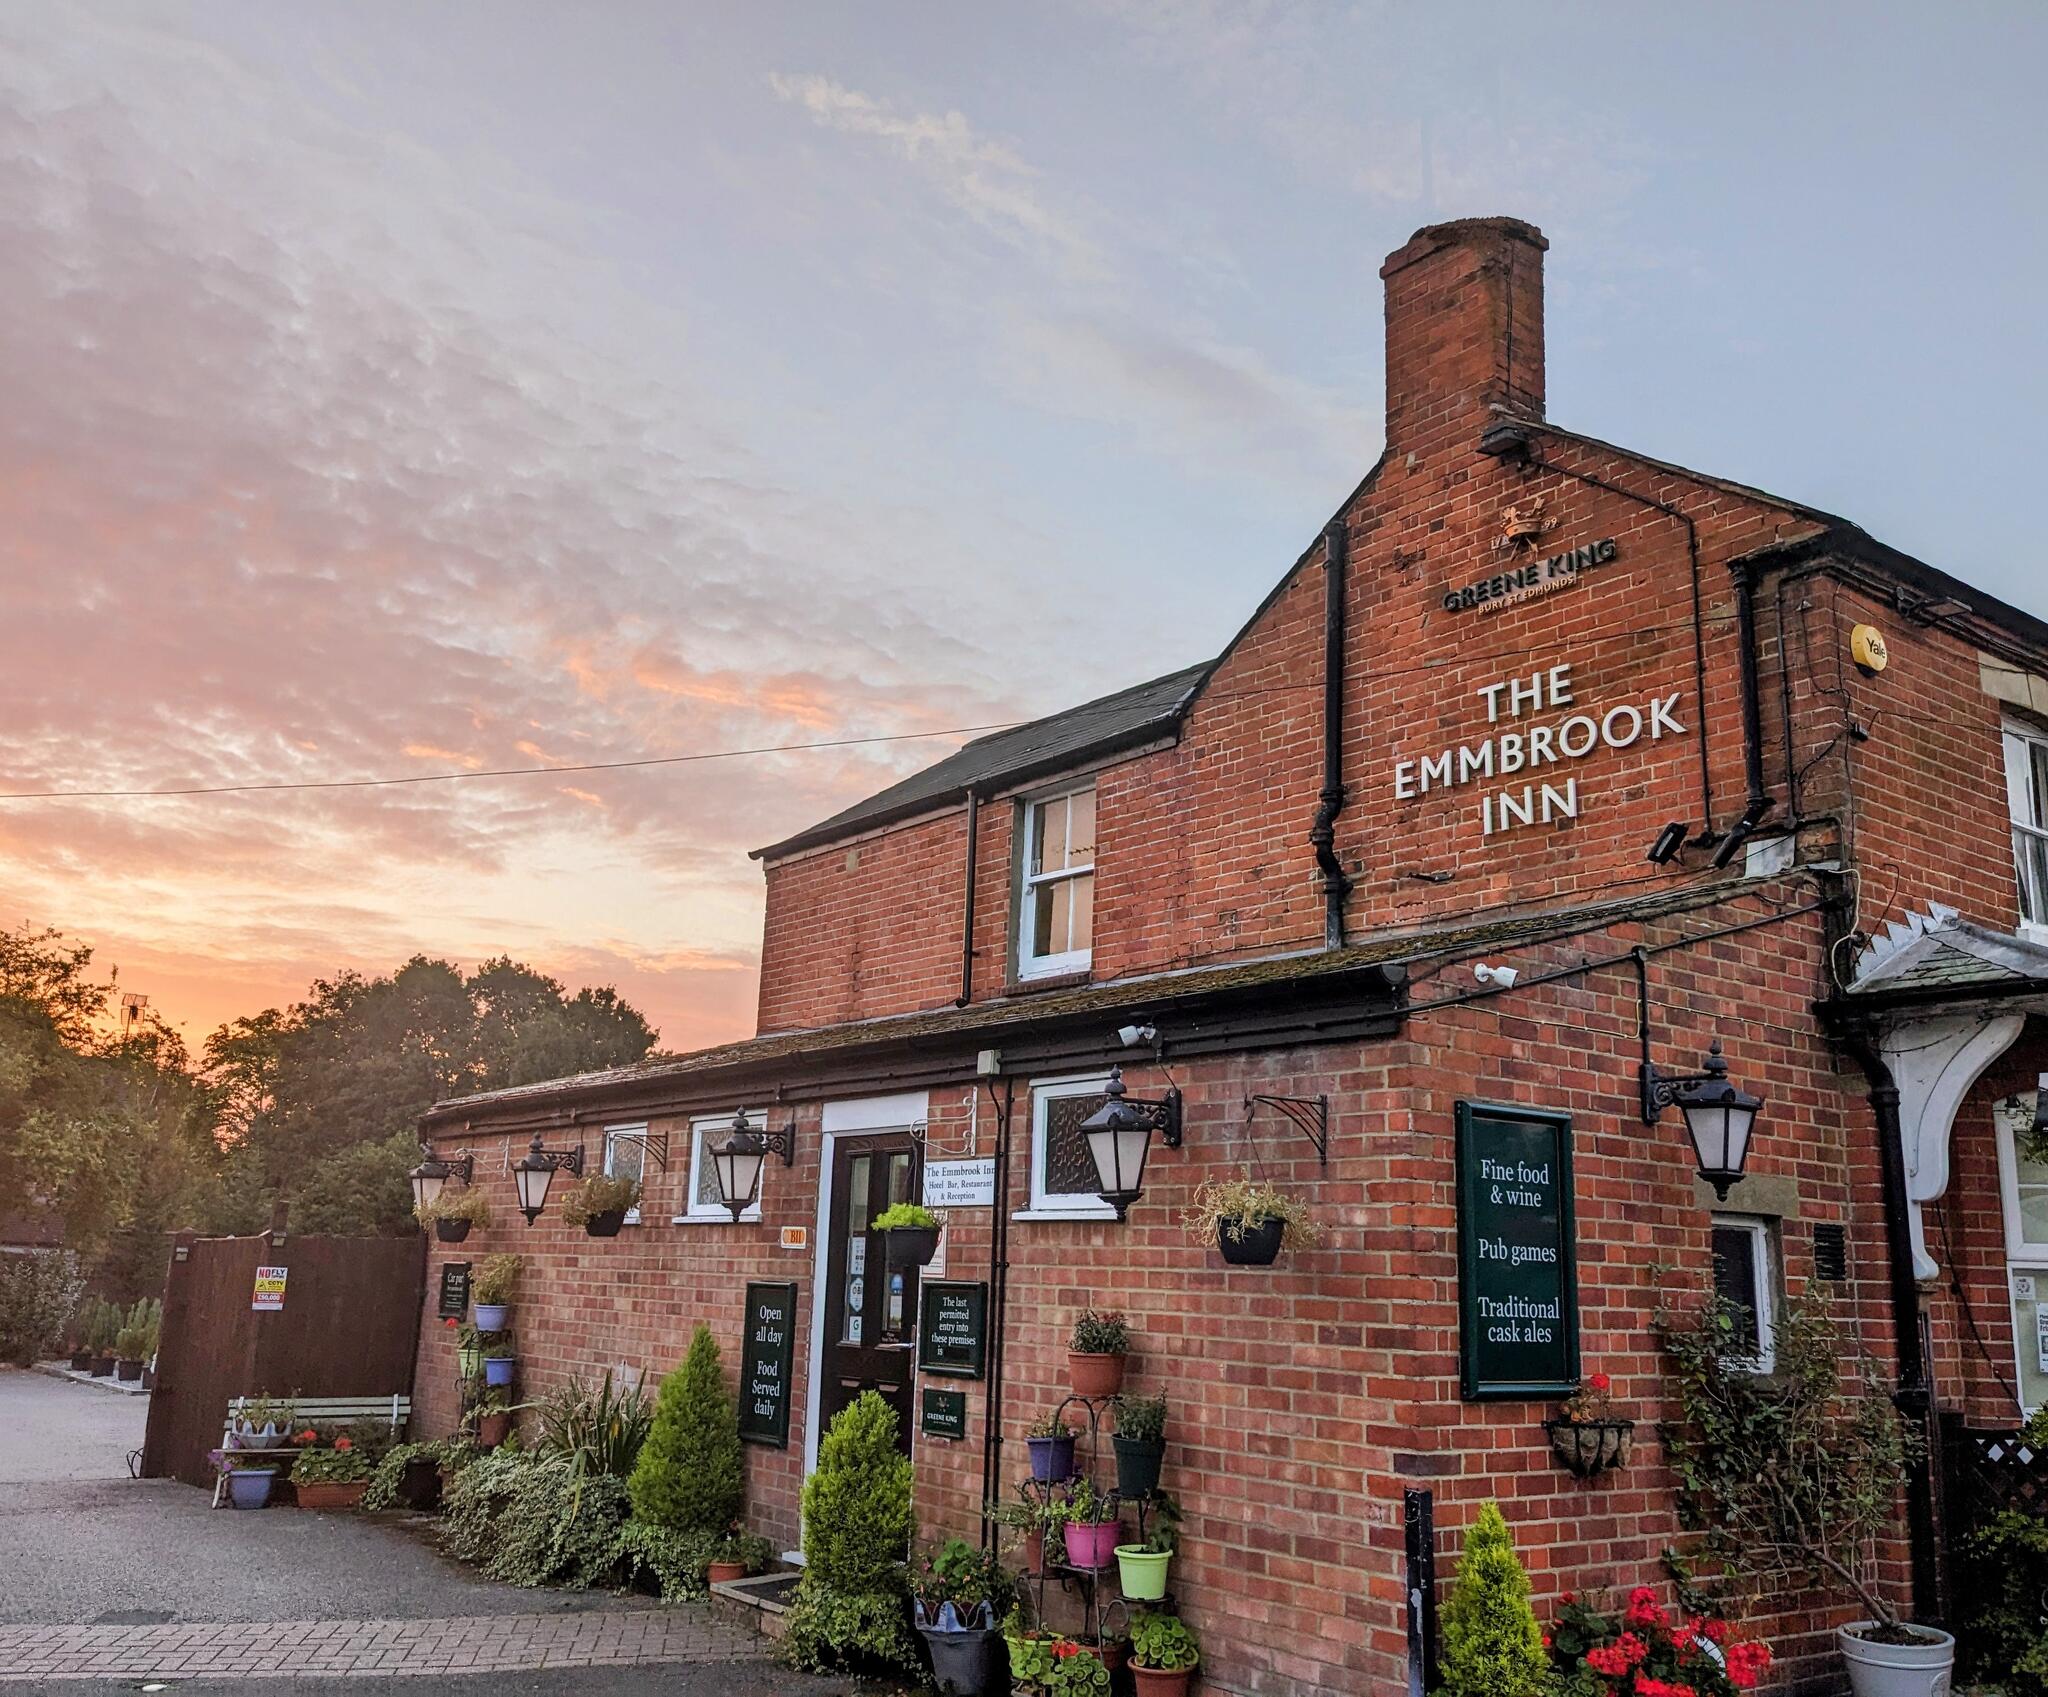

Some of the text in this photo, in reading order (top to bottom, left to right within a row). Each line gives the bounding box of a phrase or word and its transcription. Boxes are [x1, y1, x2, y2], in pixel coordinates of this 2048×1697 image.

[1443, 537, 1617, 611] GREENE KING
[1478, 576, 1574, 615] BURY ST EDMUNDS
[1866, 637, 1886, 659] Yale
[1477, 663, 1574, 723] THE
[1395, 692, 1688, 800] EMMBROOK
[1483, 778, 1578, 835] INN
[927, 1167, 940, 1178] The
[942, 1164, 981, 1177] Emmbrook
[1480, 1159, 1550, 1185] Fine food
[929, 1180, 992, 1190] Hotel Bar, Restaurant
[947, 1191, 976, 1202] Reception
[1490, 1184, 1542, 1207] & wine
[1478, 1238, 1556, 1266] Pub games
[259, 1269, 270, 1278] NO
[943, 1297, 967, 1307] The last
[1477, 1296, 1560, 1319] Traditional
[759, 1305, 782, 1323] Open
[939, 1309, 969, 1321] permitted
[755, 1326, 783, 1347] all day
[939, 1321, 969, 1333] entry into
[1488, 1320, 1552, 1343] cask ales
[931, 1334, 977, 1346] these premises
[937, 1345, 943, 1356] is
[757, 1360, 778, 1376] Food
[752, 1379, 780, 1397] Served
[754, 1398, 776, 1420] daily
[927, 1412, 945, 1421] GREENE
[945, 1414, 958, 1424] KING
